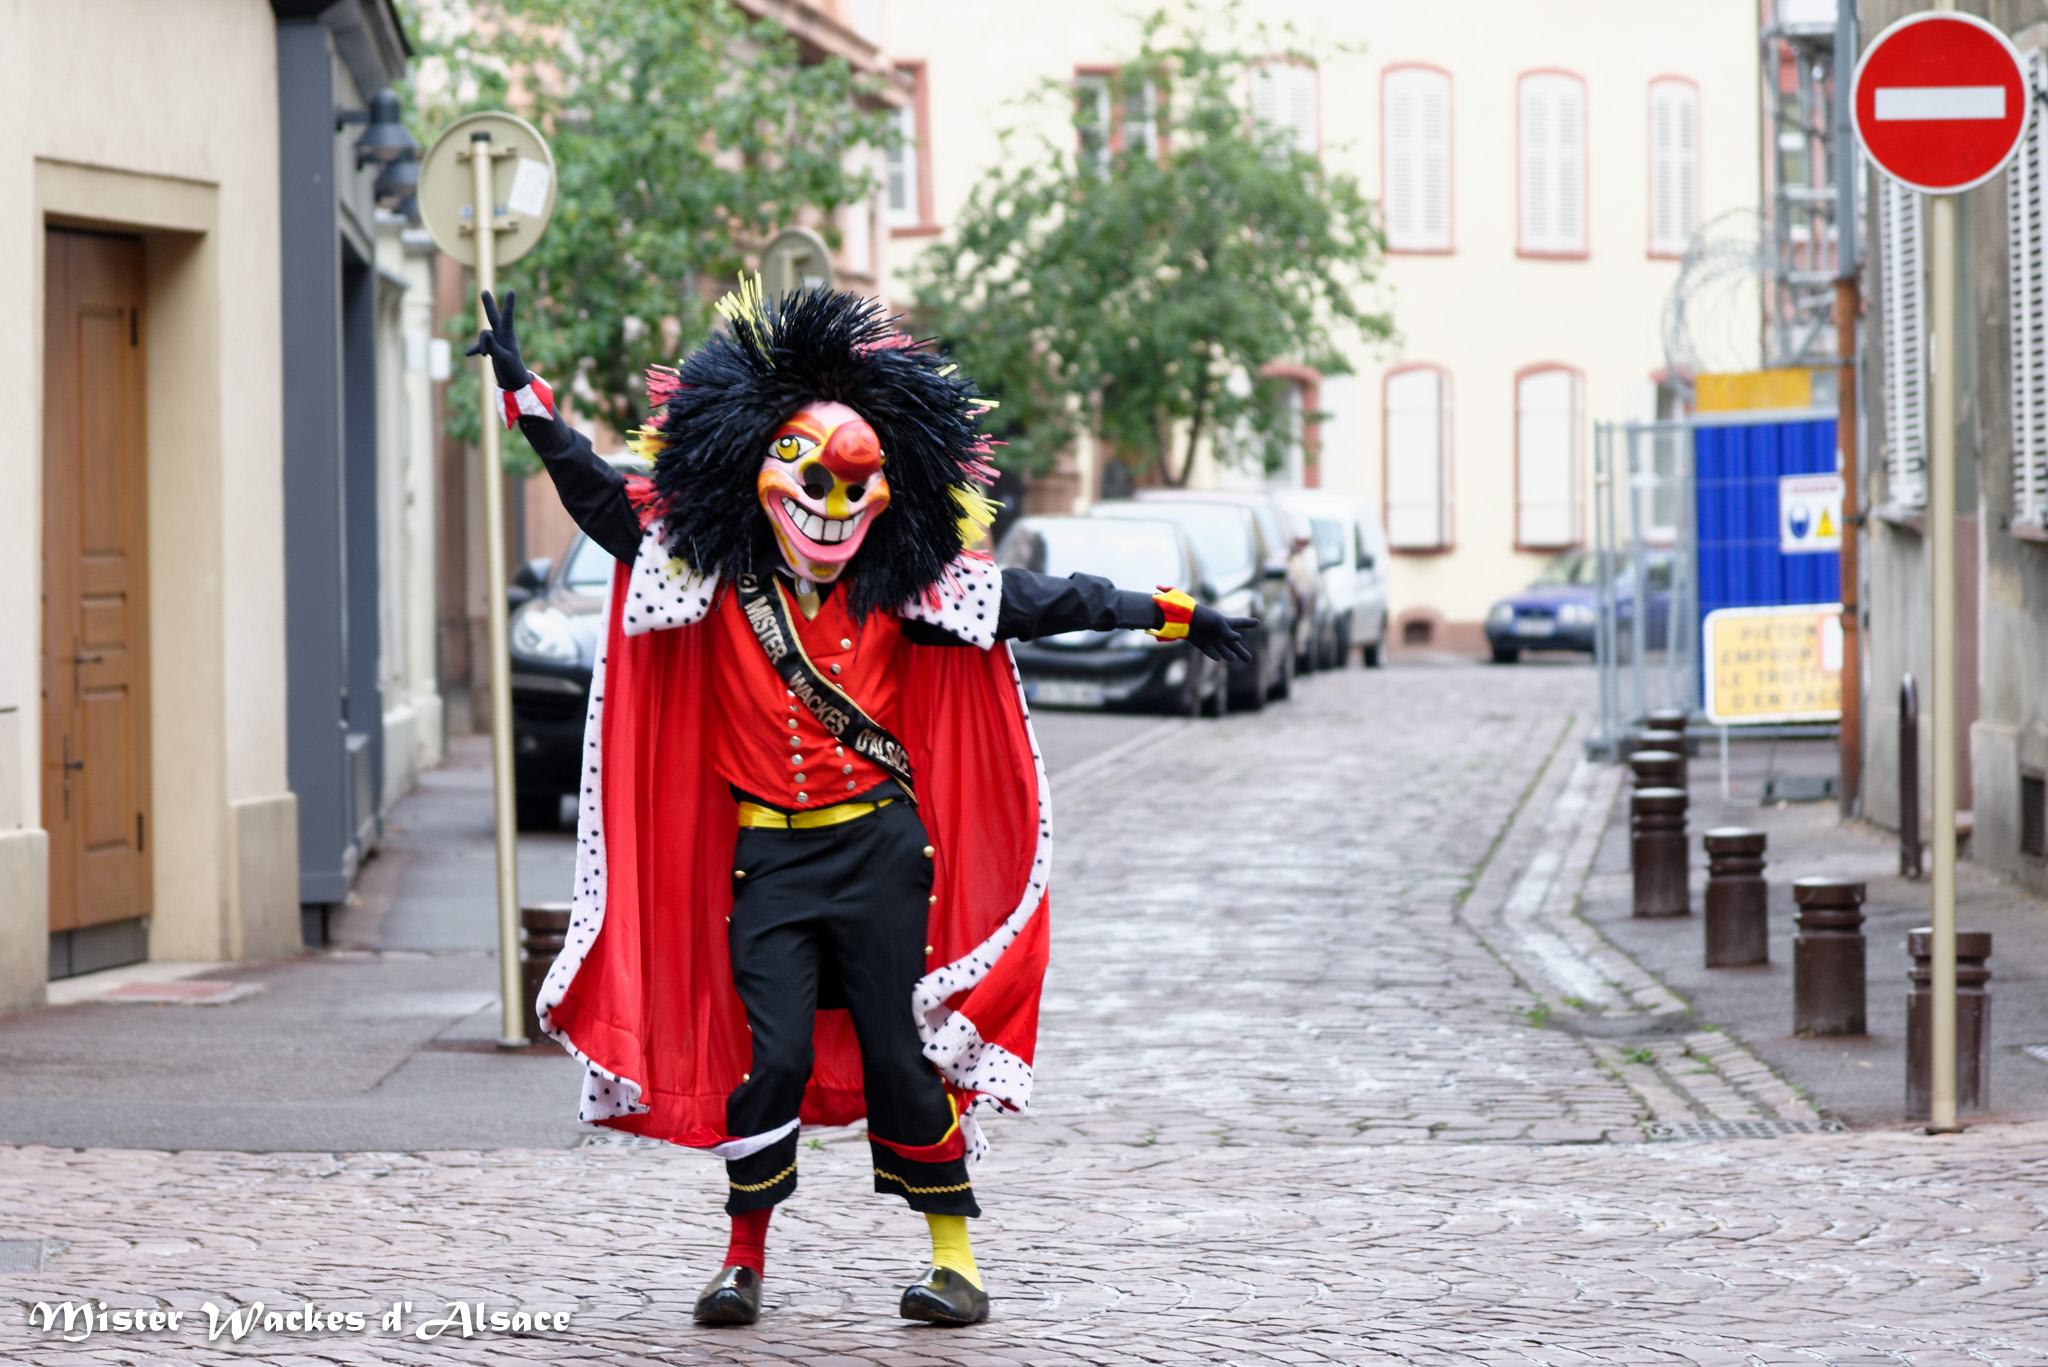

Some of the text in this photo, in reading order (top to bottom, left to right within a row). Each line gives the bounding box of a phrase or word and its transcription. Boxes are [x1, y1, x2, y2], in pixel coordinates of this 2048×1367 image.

[1741, 621, 1816, 640] PIÉTON
[744, 596, 787, 664] MISTER
[789, 671, 850, 735] WACKES
[1720, 646, 1812, 666] EMPRUN
